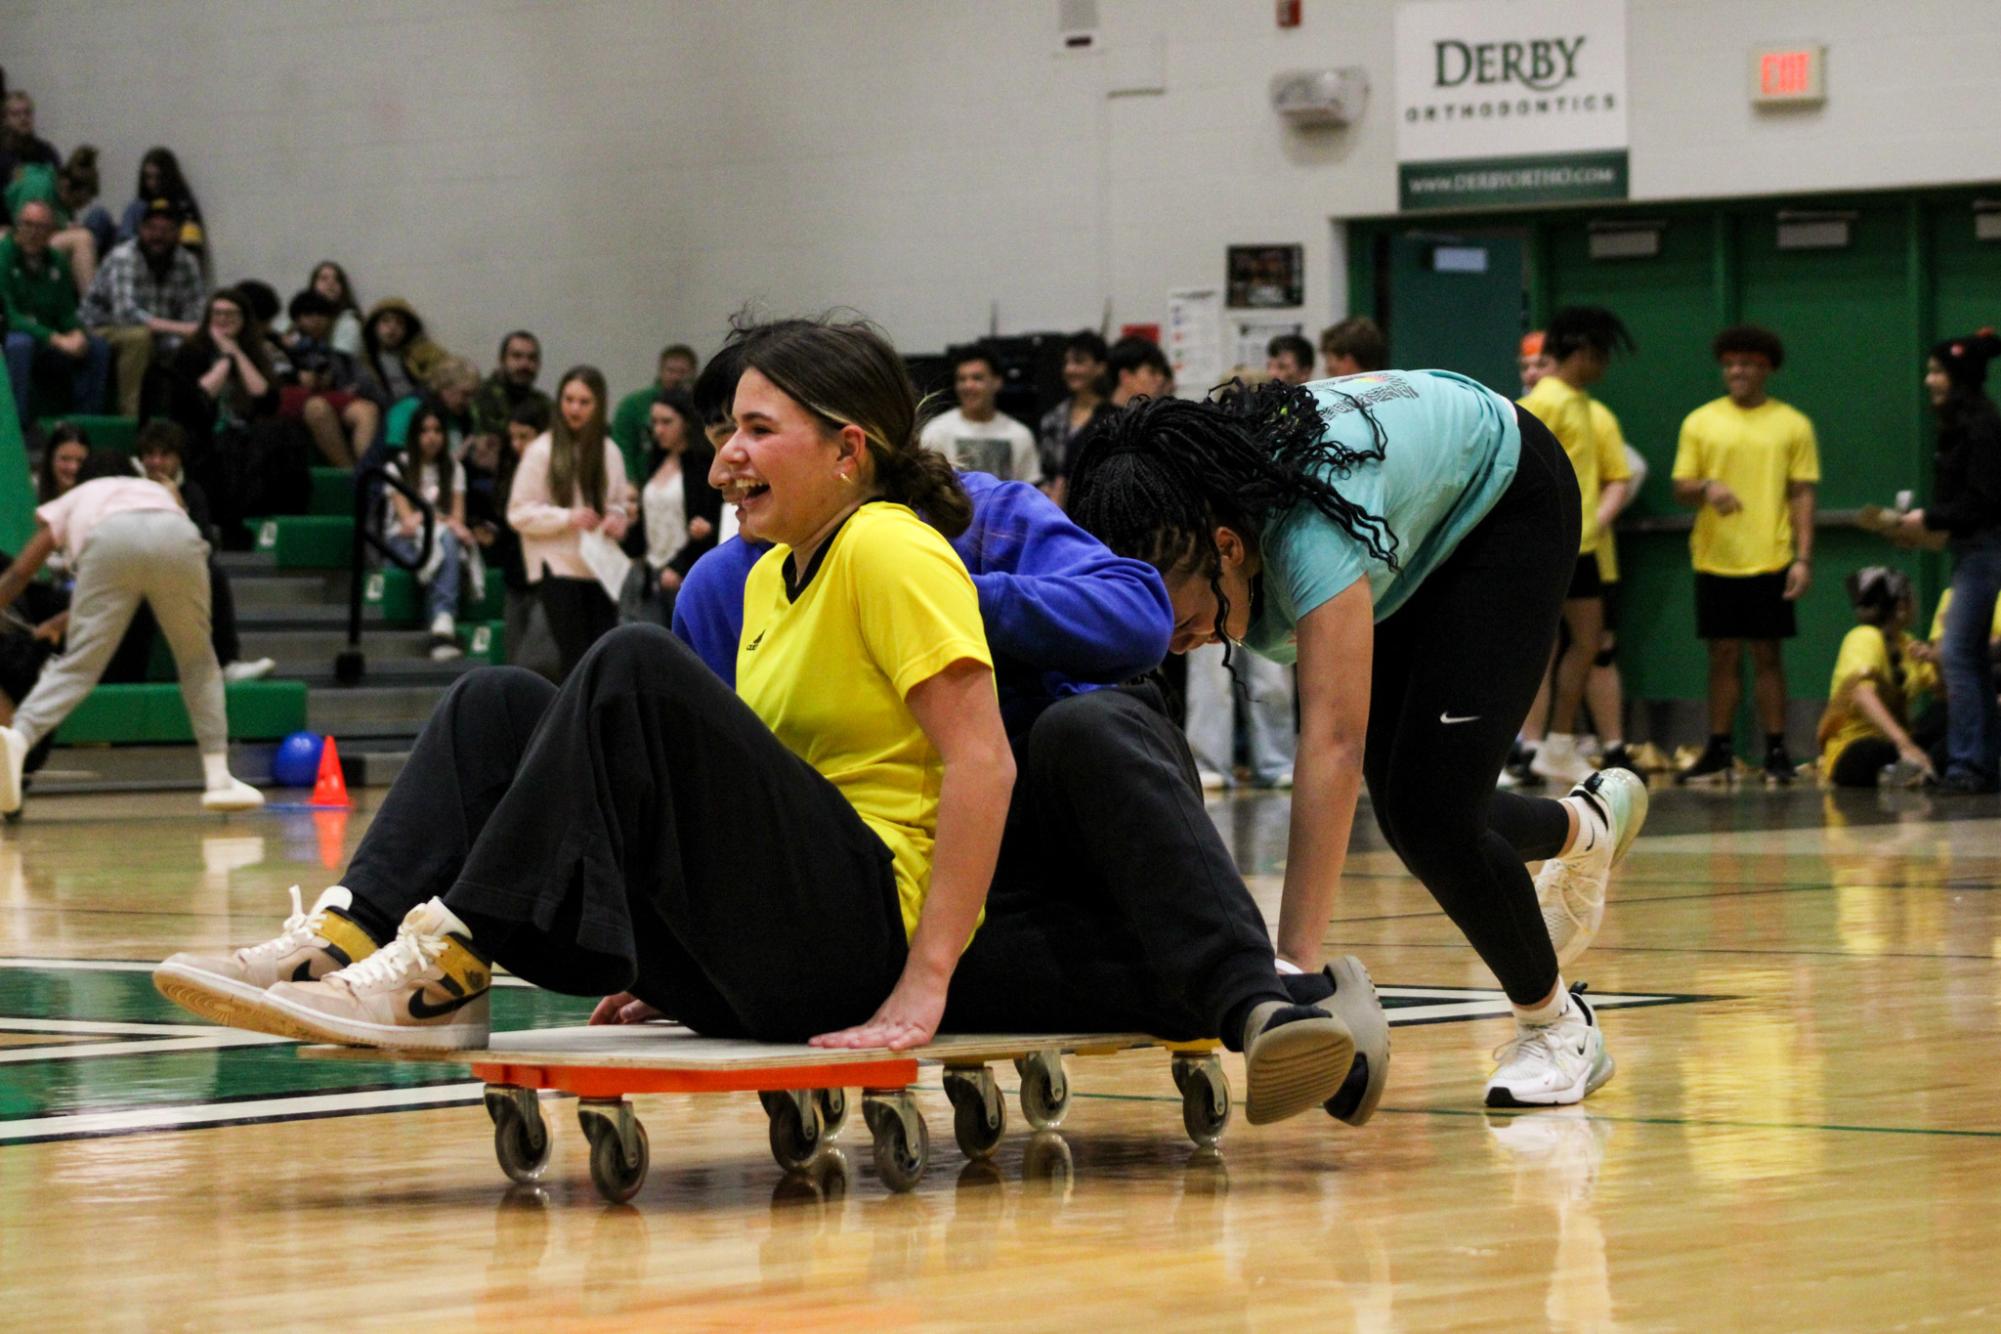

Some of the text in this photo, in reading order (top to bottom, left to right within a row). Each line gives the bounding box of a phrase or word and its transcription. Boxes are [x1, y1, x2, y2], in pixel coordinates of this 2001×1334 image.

[1434, 36, 1584, 91] DERBY
[1762, 53, 1808, 94] EXIT
[1406, 94, 1614, 122] ORTHODONTICS
